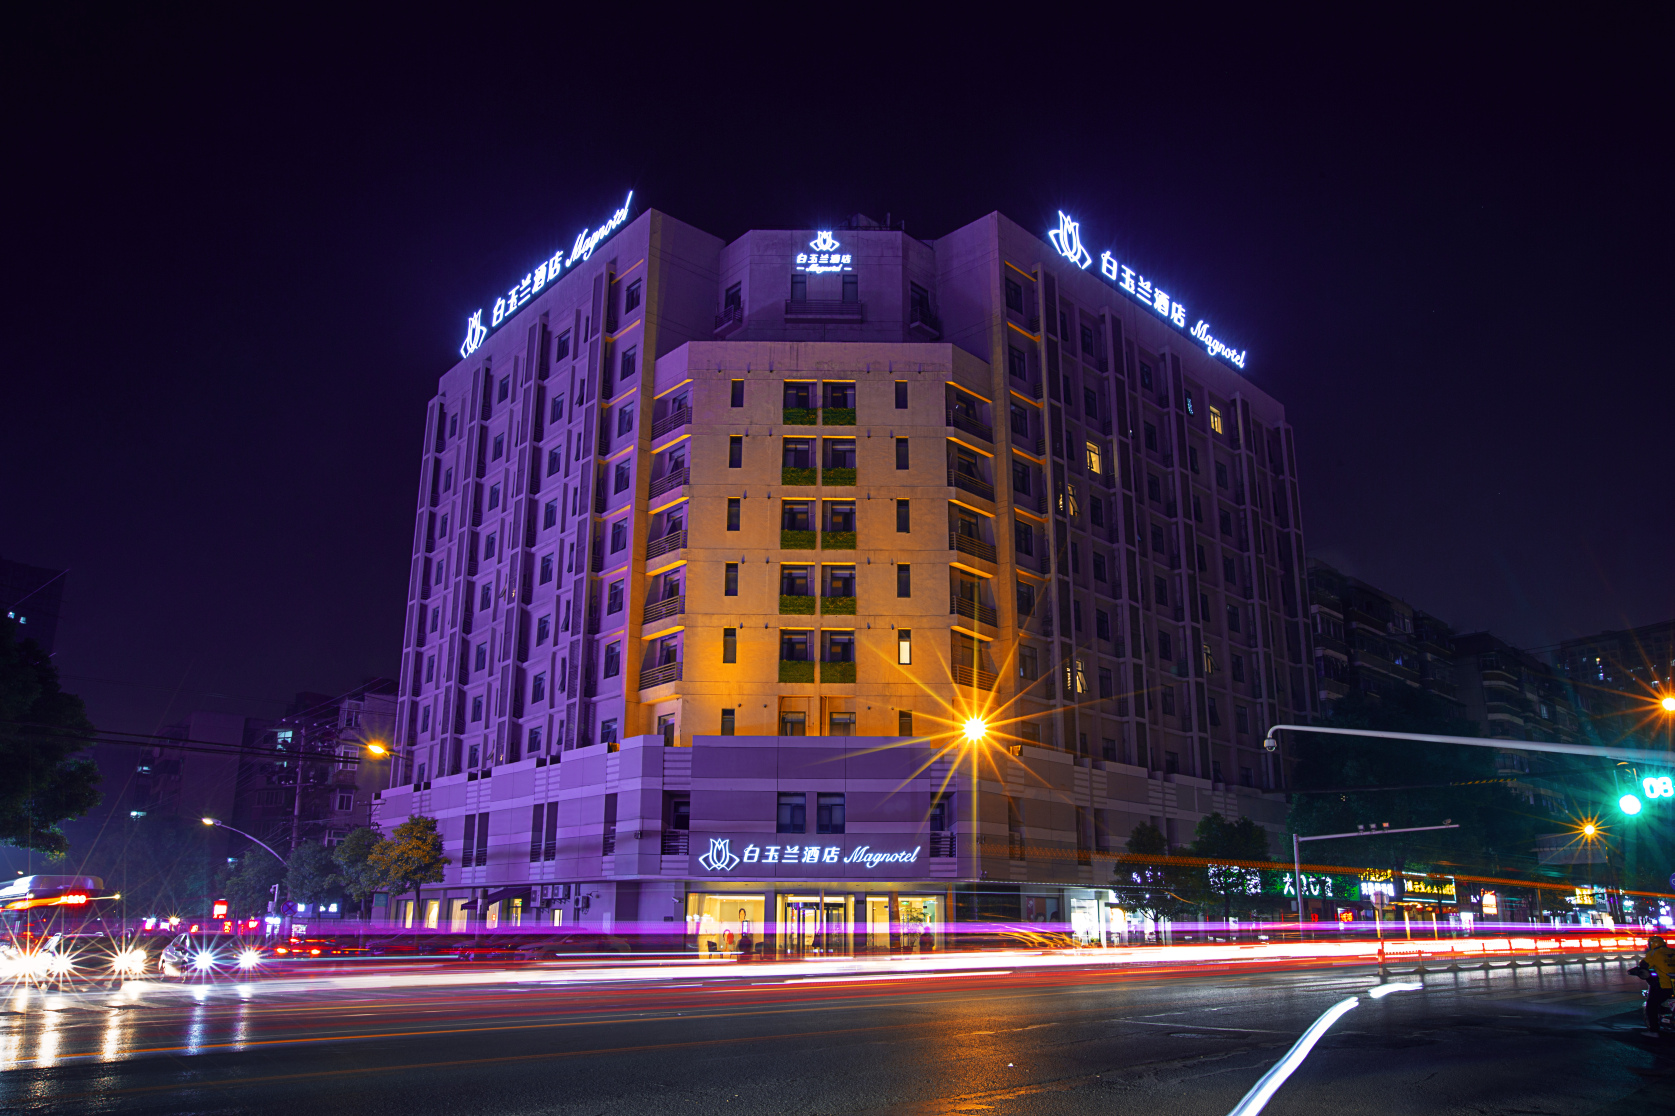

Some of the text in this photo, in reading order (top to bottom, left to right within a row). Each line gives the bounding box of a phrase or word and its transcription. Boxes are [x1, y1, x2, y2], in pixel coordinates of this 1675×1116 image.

[565, 190, 633, 268] Magnotel
[491, 250, 564, 327] 白玉兰酒店
[1100, 250, 1186, 328] 白玉兰酒店
[1190, 319, 1246, 369] Magnotel
[742, 843, 841, 864] 白玉兰酒店
[843, 845, 921, 869] Magnotel
